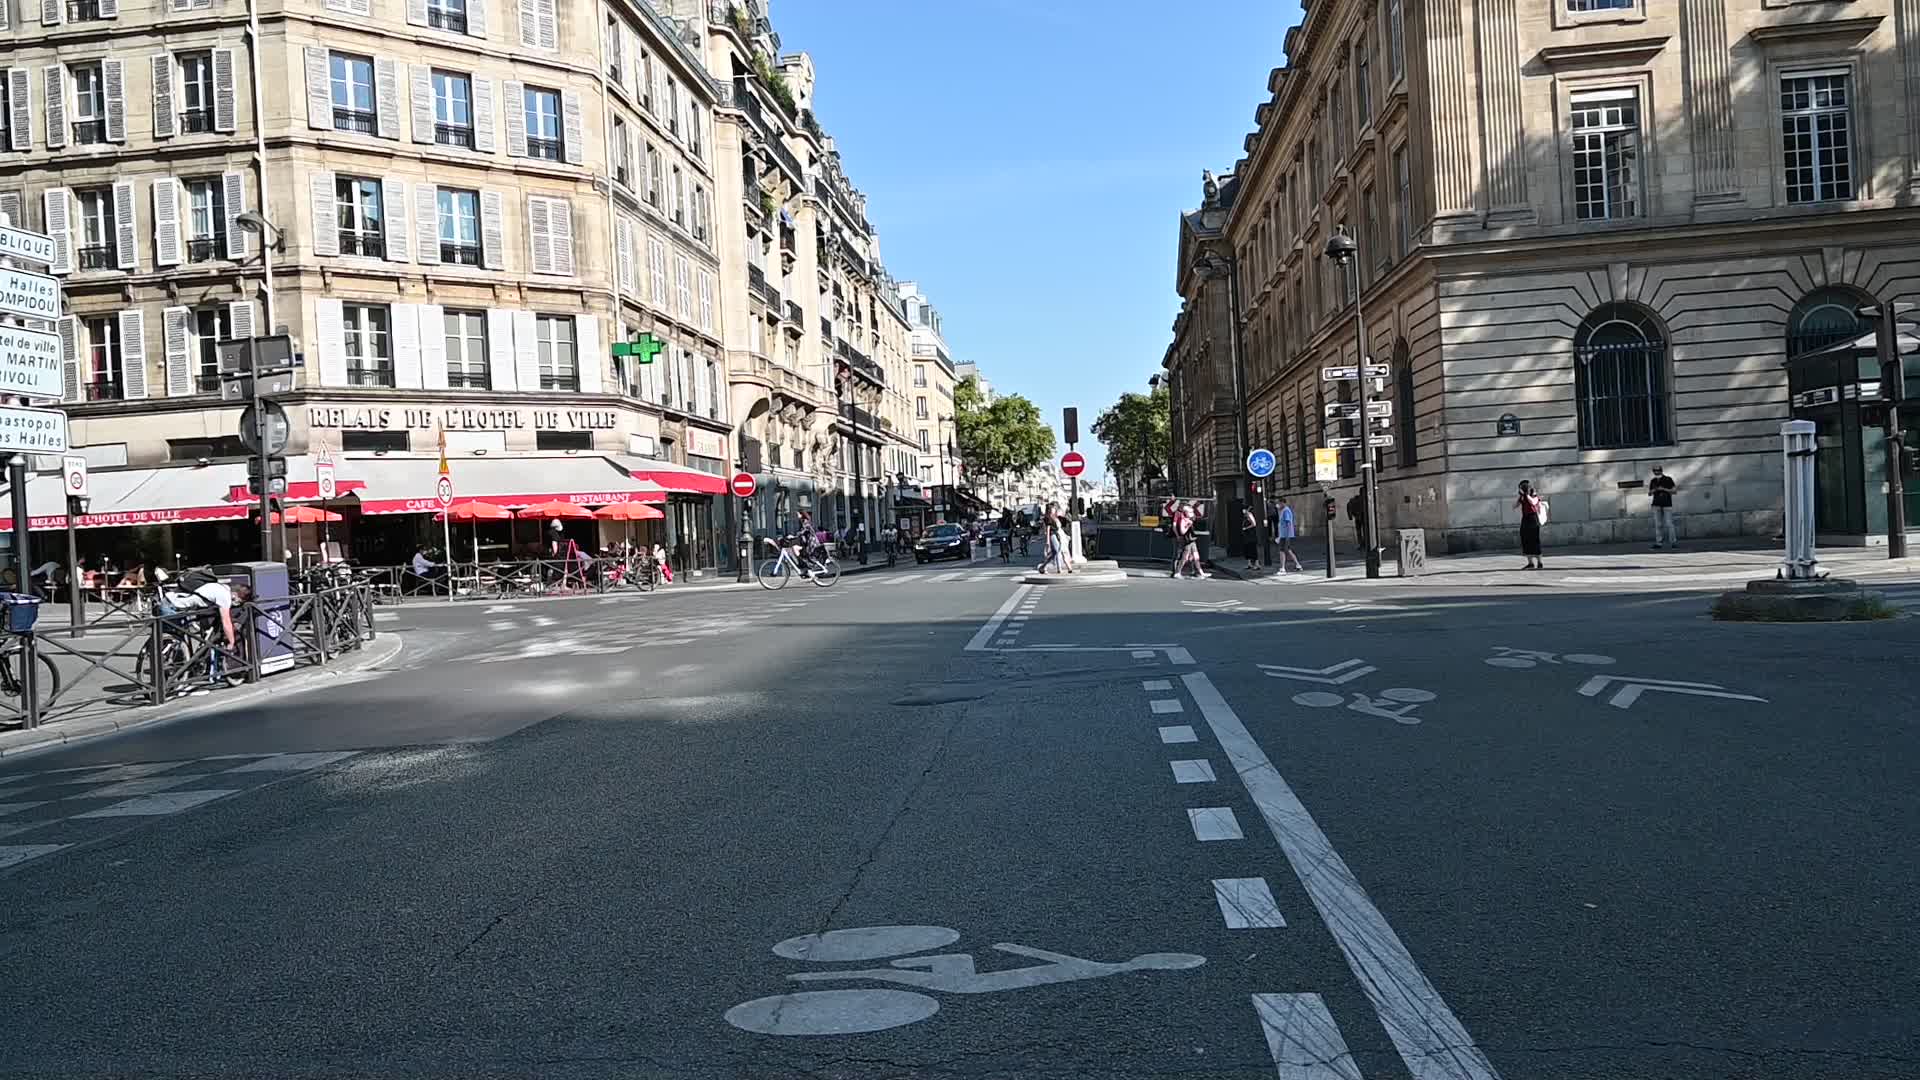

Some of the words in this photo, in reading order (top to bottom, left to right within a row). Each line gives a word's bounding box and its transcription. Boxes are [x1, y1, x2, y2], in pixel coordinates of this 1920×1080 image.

[0, 233, 50, 256] BLIQUE
[10, 277, 54, 296] Halles
[17, 337, 31, 350] de
[34, 340, 56, 353] ville
[7, 352, 58, 371] MARTIN
[0, 370, 38, 386] IVOLI
[309, 408, 390, 428] RELAIS
[404, 409, 432, 428] DE
[445, 409, 524, 428] L'HOTEL
[533, 411, 560, 429] DE
[567, 411, 616, 429] VILLE
[20, 431, 62, 447] Halles
[569, 493, 630, 503] RESTAURANT
[31, 516, 68, 526] RELAIS
[86, 512, 130, 524] L'HOTEL
[133, 511, 148, 520] DE
[150, 509, 181, 520] VILLE
